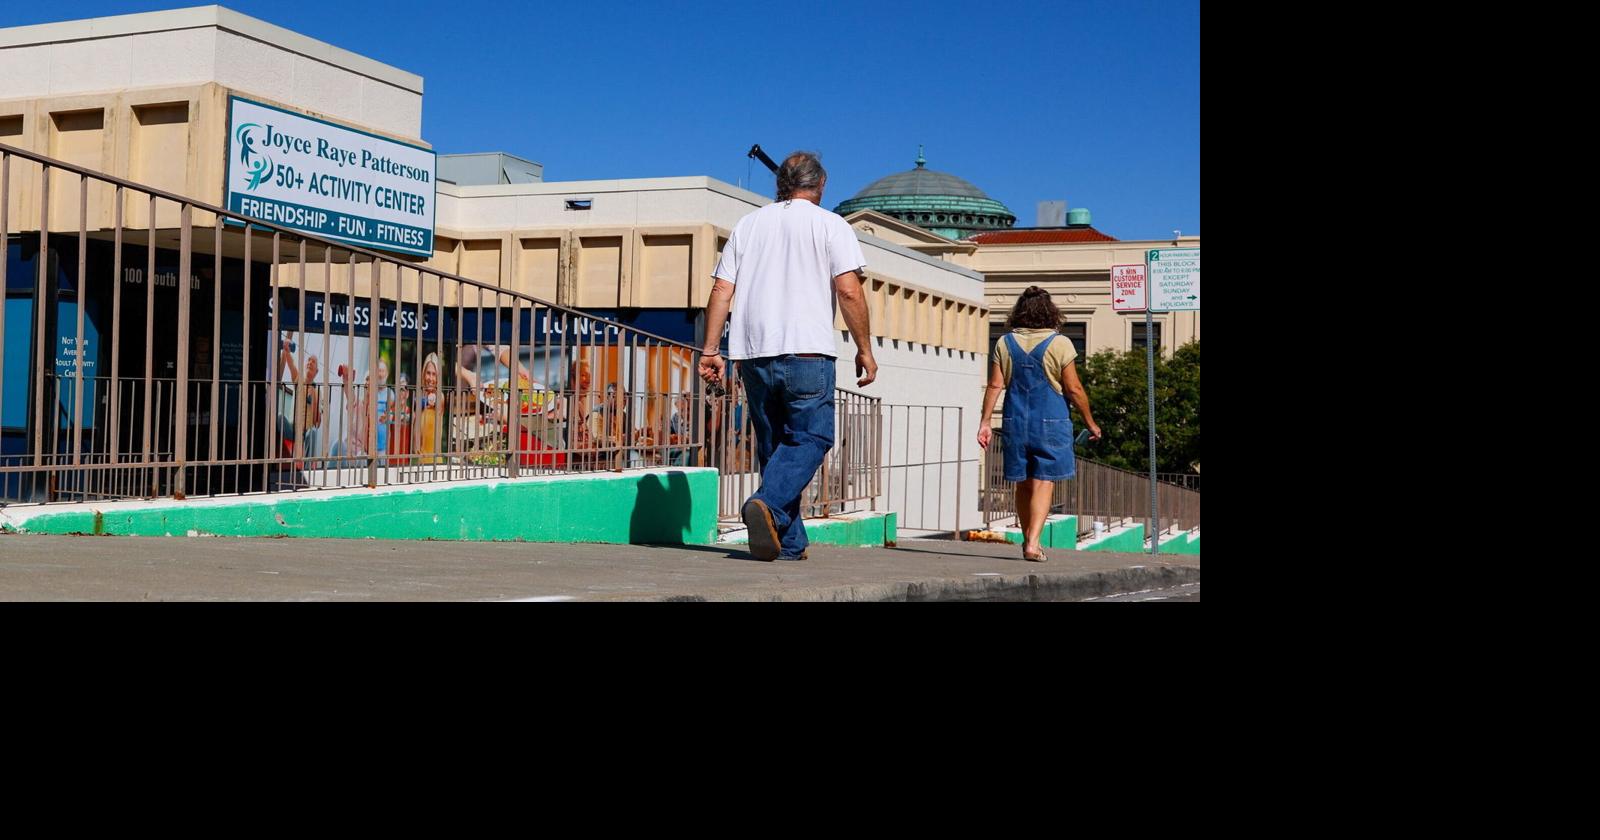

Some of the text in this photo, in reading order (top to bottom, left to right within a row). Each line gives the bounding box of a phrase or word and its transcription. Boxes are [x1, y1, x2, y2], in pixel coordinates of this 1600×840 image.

[262, 124, 430, 183] Joyce Raye Patterson
[276, 164, 425, 216] 50+ ACTIVITY CENTER
[240, 198, 424, 247] FRIENDSHIP FUN FITNESS
[124, 267, 143, 284] 100
[150, 271, 176, 287] outh
[1152, 251, 1158, 260] 2
